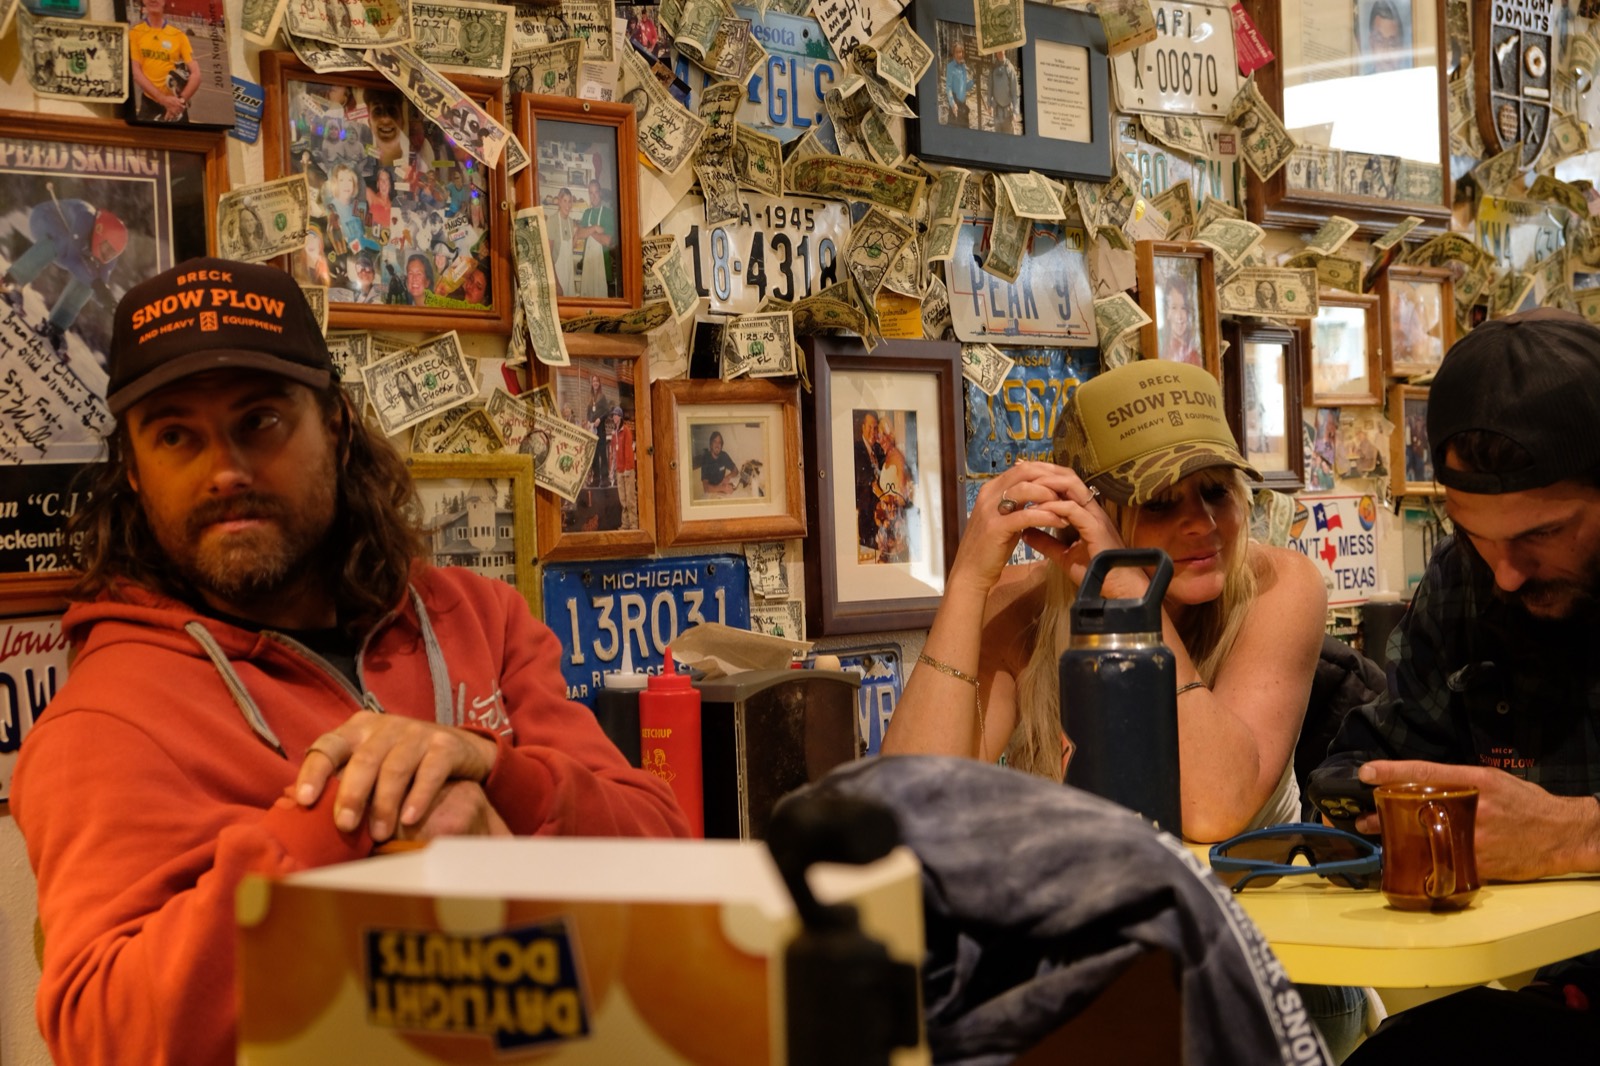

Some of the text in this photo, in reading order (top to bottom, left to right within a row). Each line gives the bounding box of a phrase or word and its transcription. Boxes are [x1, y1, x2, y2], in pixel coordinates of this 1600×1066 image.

[413, 18, 450, 29] 2024
[1494, 4, 1549, 33] DONUTS
[1235, 8, 1251, 32] Flora
[1249, 28, 1268, 60] Paraiso
[214, 62, 224, 88] 2013
[176, 270, 233, 286] BRECK
[131, 288, 286, 331] SNOW PLOW
[138, 315, 284, 343] AND HEAVY EQUIPMENT
[1138, 374, 1181, 390] BRECK
[1106, 388, 1217, 429] SNOW PLOW
[1119, 412, 1222, 441] AND HEAVY EQUIPMENT
[1338, 533, 1375, 557] MESS
[602, 568, 699, 591] MICHIGAN
[1334, 566, 1377, 591] TEXAS
[1503, 757, 1536, 769] PLOW
[379, 932, 560, 986] DONUTS
[374, 980, 580, 1036] DAYLIGHT
